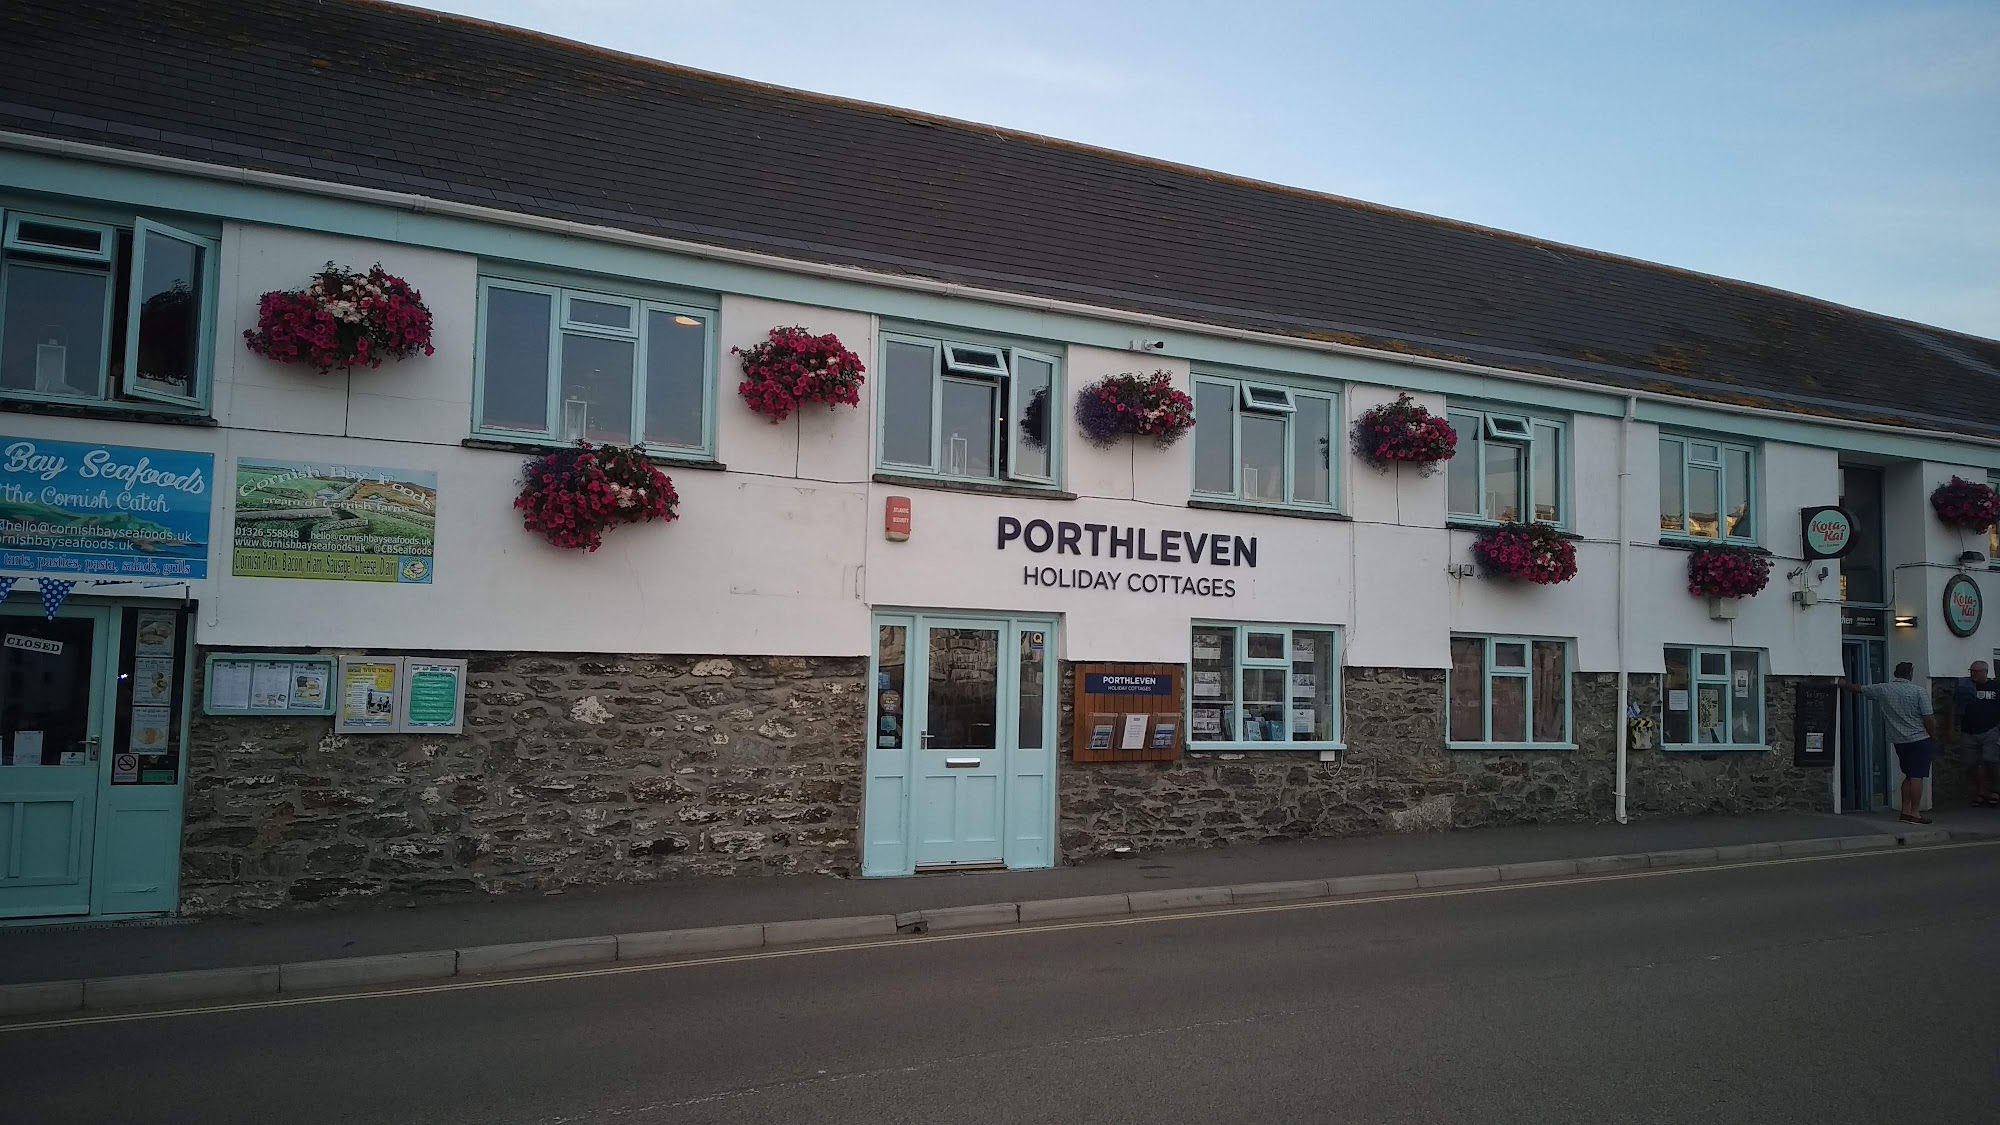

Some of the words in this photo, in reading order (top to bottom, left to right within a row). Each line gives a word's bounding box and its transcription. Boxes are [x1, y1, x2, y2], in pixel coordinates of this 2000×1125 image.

[4, 442, 68, 481] Bay
[79, 450, 206, 494] Seafoods
[239, 465, 321, 498] Cornish
[330, 464, 369, 484] Bay
[379, 472, 433, 510] Foods
[4, 483, 36, 504] the
[41, 486, 112, 510] Cornish
[116, 491, 171, 513] Catch
[262, 497, 301, 507] cream
[305, 497, 320, 508] of
[322, 499, 372, 512] Cornish
[376, 501, 410, 514] farms
[6, 520, 192, 542] hello@cornishbayseafoods.uk
[235, 526, 264, 538] 01326
[266, 528, 300, 539] 558848
[1812, 521, 1844, 533] Kota
[310, 531, 432, 547] hello@cornishbayseafoods.uk
[997, 515, 1257, 568] PORTHLEVEN
[1824, 530, 1844, 541] Kai
[373, 544, 432, 556] @CBSeafoods
[37, 554, 82, 570] pasties,
[85, 557, 119, 573] pasta,
[121, 557, 160, 574] salads,
[162, 559, 191, 575] grills
[235, 550, 261, 571] Cornish
[380, 557, 397, 579] Dairy
[1023, 565, 1122, 591] HOLIDAY
[1127, 572, 1236, 598] COTTAGES
[1953, 592, 1974, 606] Kota
[1961, 605, 1976, 617] Kai
[7, 637, 60, 652] CLOSED
[1102, 676, 1156, 685] PORTHLEVEN
